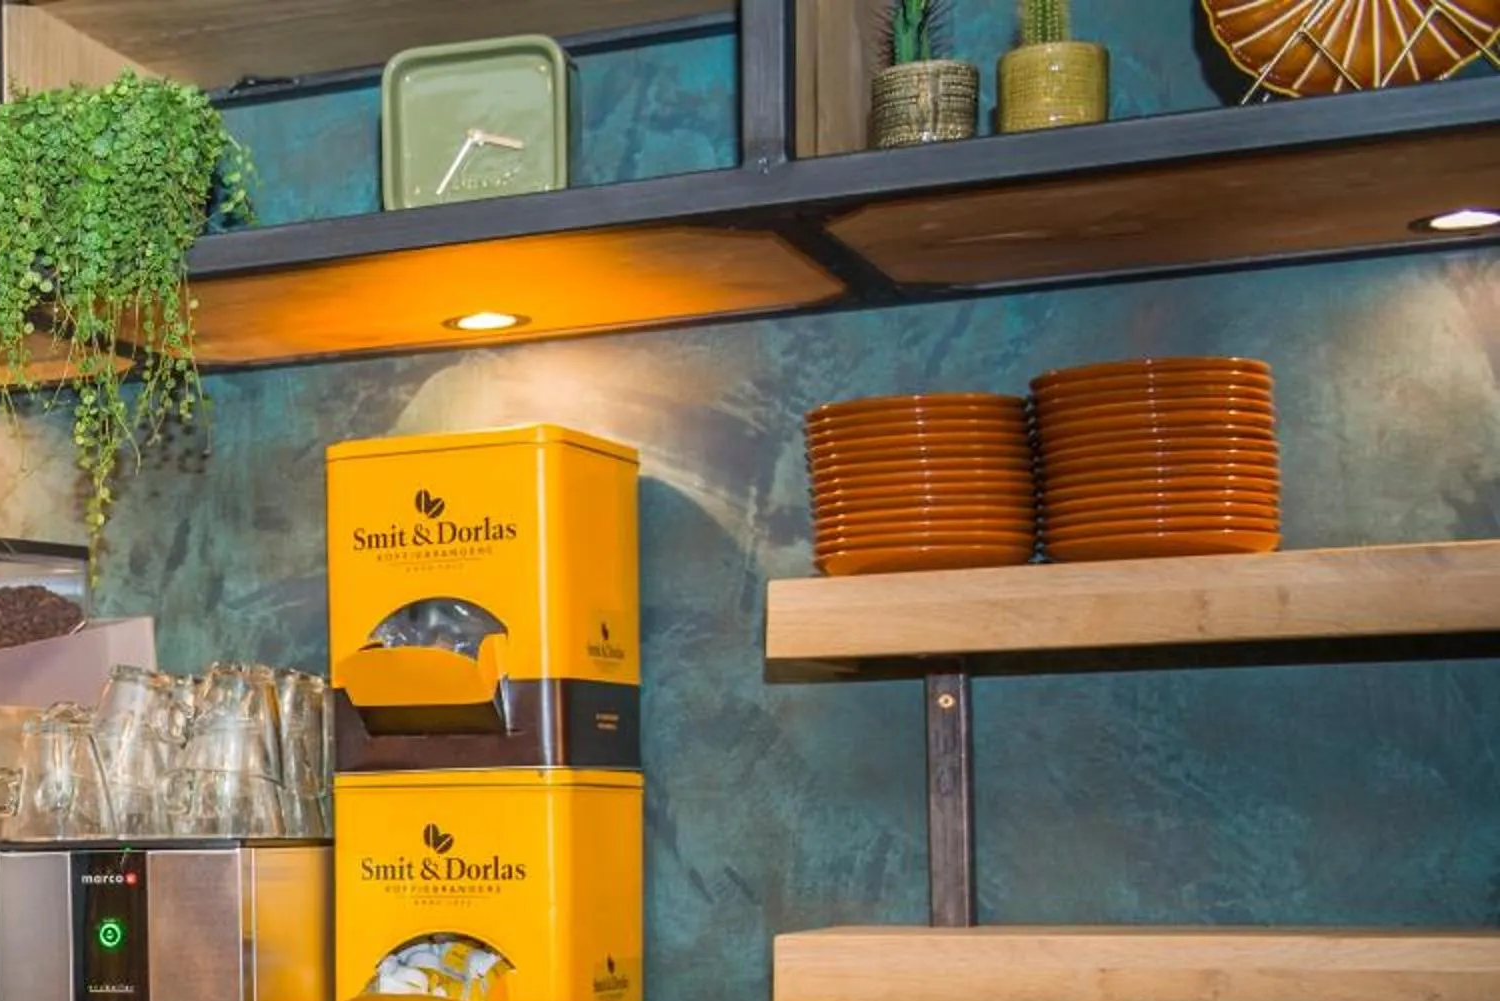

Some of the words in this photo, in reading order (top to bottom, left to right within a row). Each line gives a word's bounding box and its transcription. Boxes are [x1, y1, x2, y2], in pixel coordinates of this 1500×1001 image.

[353, 524, 406, 551] Smit
[412, 523, 434, 546] &
[437, 516, 517, 545] Dorlas
[81, 874, 124, 884] marco
[361, 856, 414, 881] Smit
[420, 857, 442, 881] &
[446, 855, 527, 881] Dorlas
